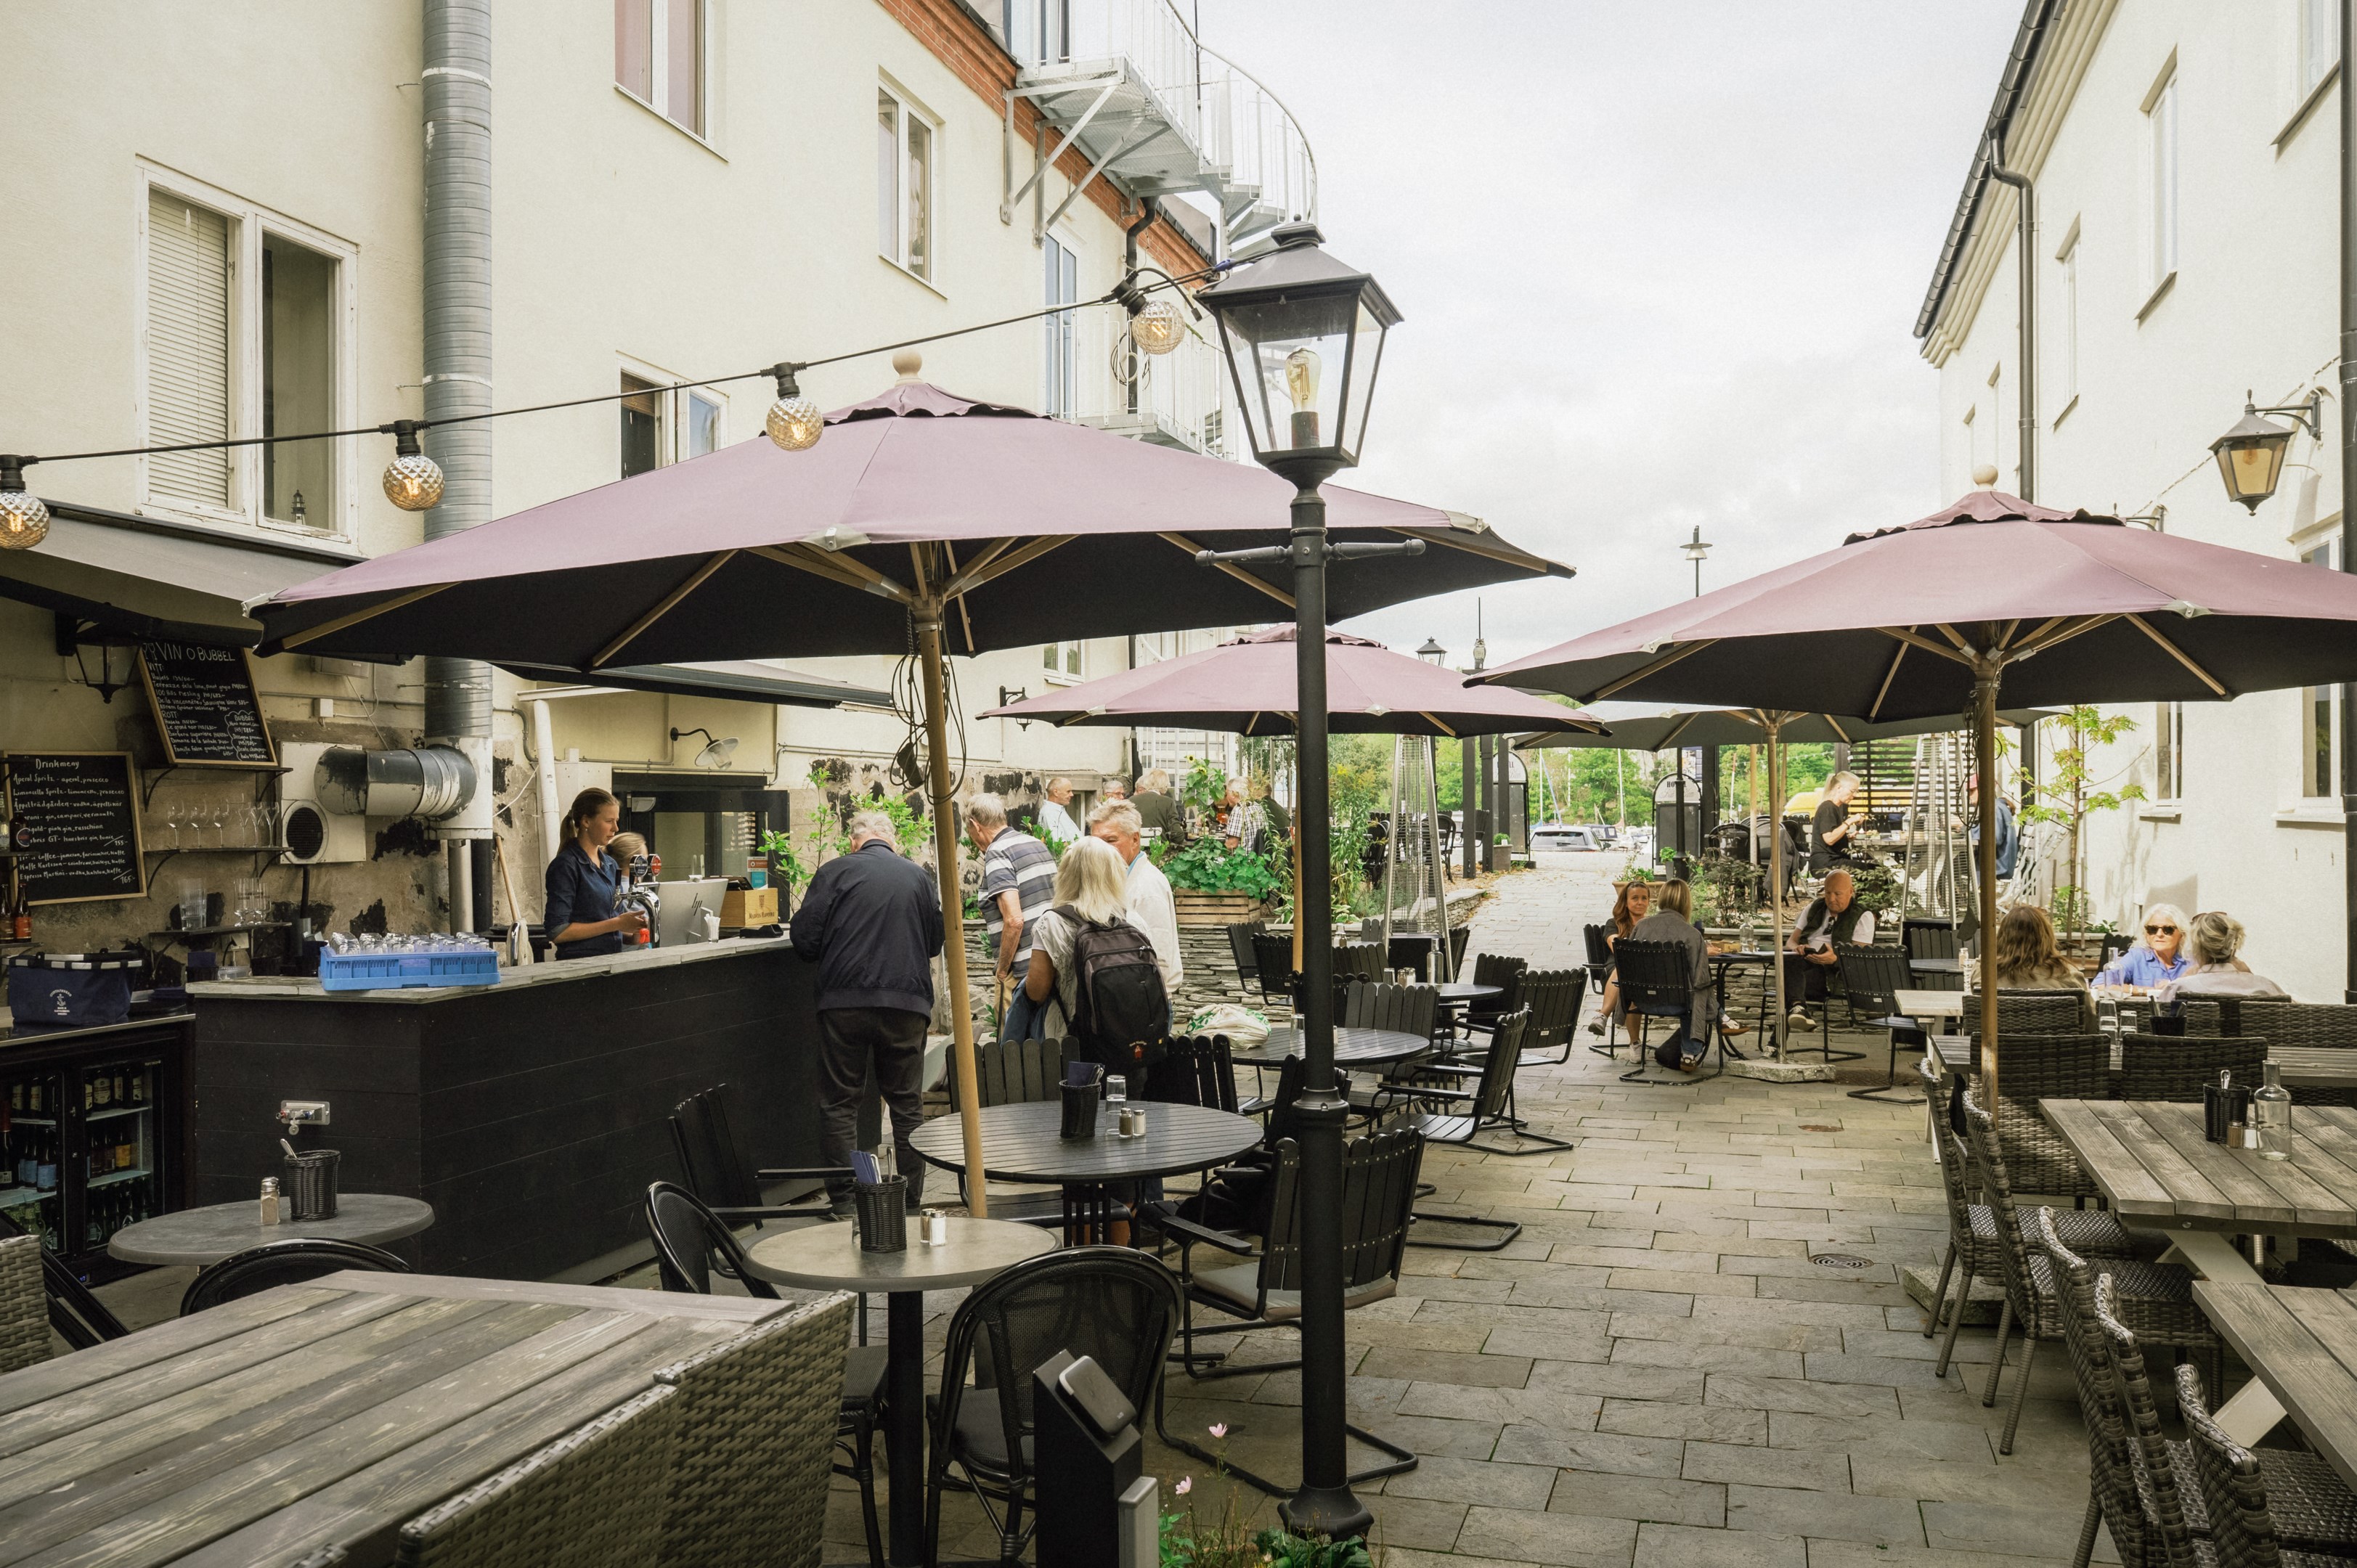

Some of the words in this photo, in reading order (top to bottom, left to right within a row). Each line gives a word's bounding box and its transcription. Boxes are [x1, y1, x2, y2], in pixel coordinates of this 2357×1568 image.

[156, 642, 182, 661] VIN
[197, 647, 235, 661] BUBBEL
[36, 758, 80, 770] Drinkmeny
[13, 772, 33, 785] Aperol
[34, 773, 55, 784] Spritz
[46, 787, 64, 796] Spritz
[84, 809, 115, 819] vermouth
[38, 852, 57, 862] coffee
[20, 862, 36, 871] Kaffe
[20, 872, 42, 883] Espresso
[43, 870, 65, 880] Martini
[691, 892, 703, 916] hp
